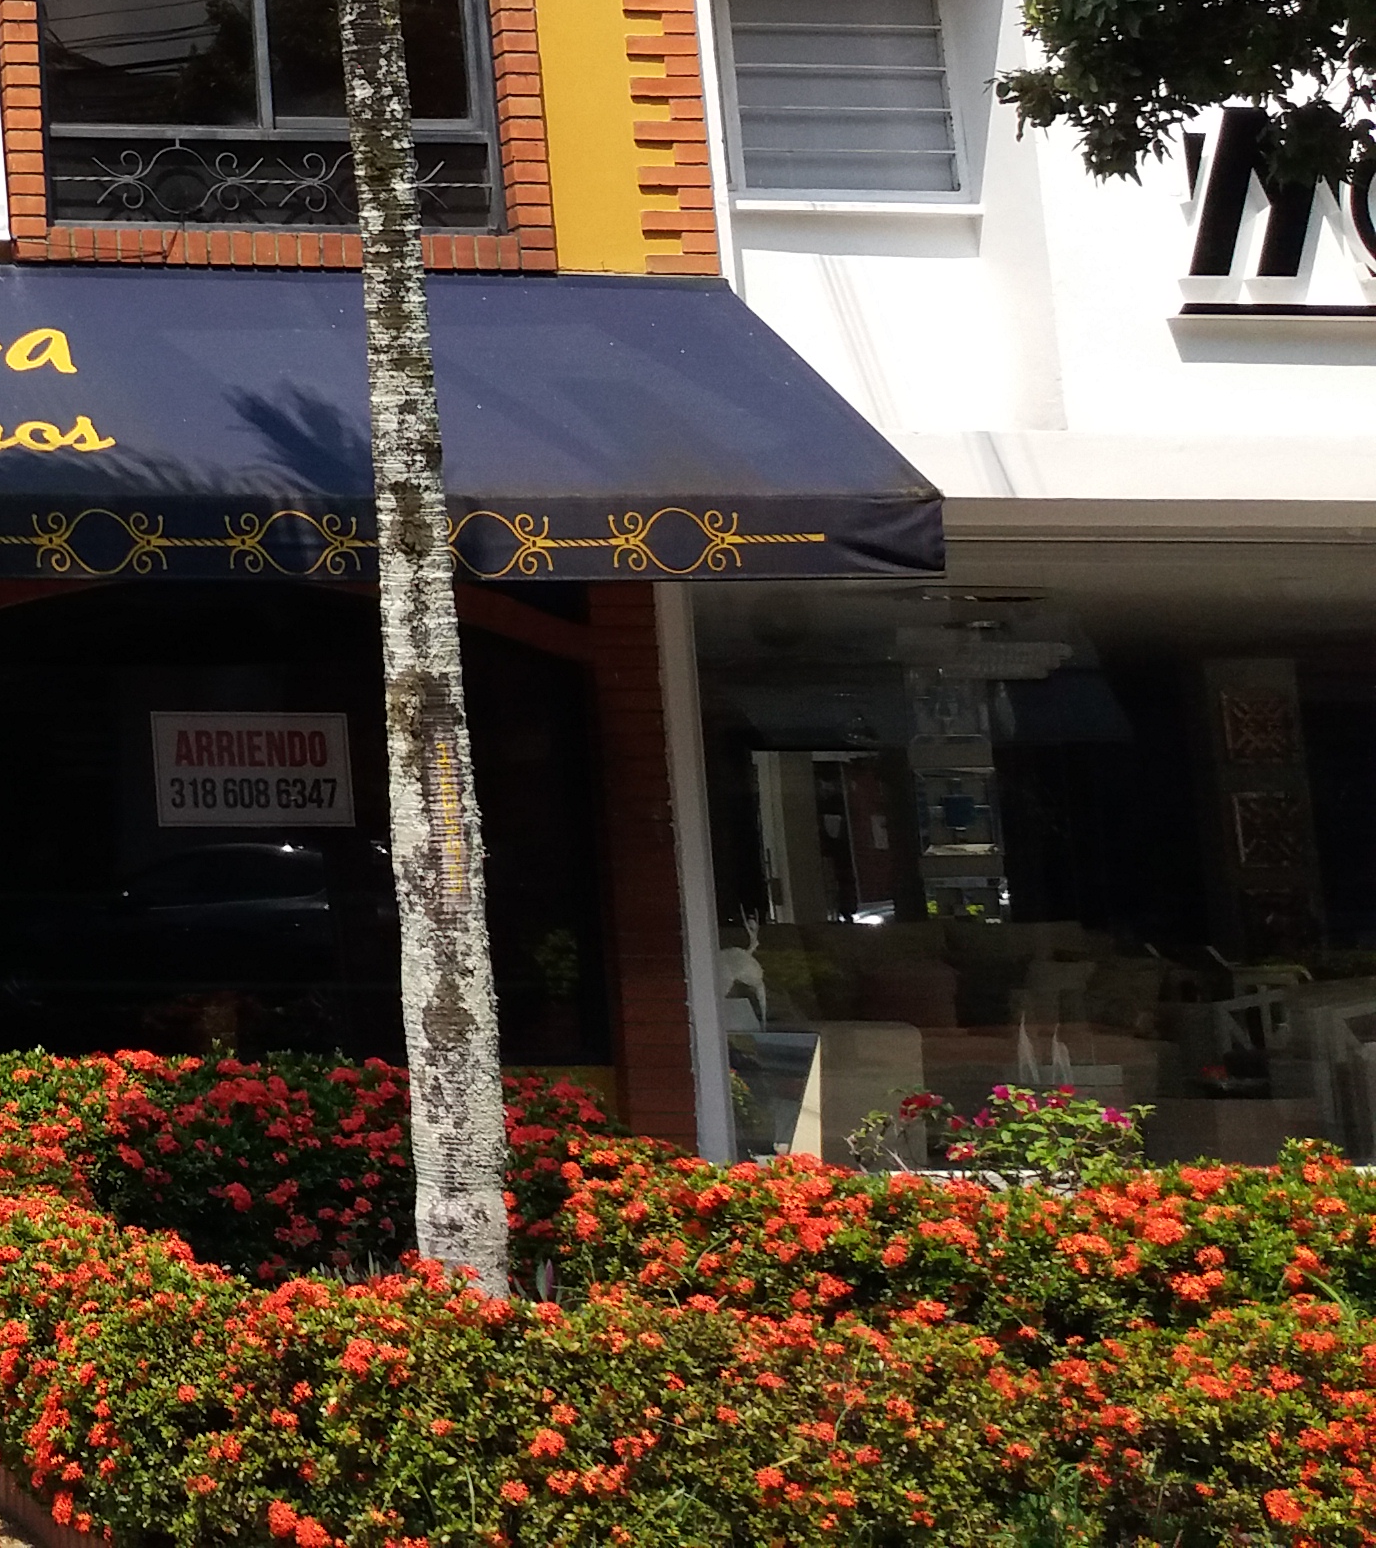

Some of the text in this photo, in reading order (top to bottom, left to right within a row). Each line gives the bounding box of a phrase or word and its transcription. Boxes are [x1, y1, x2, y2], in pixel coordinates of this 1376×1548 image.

[175, 730, 328, 768] ARRIENDO
[170, 778, 337, 810] 318 608 6347
